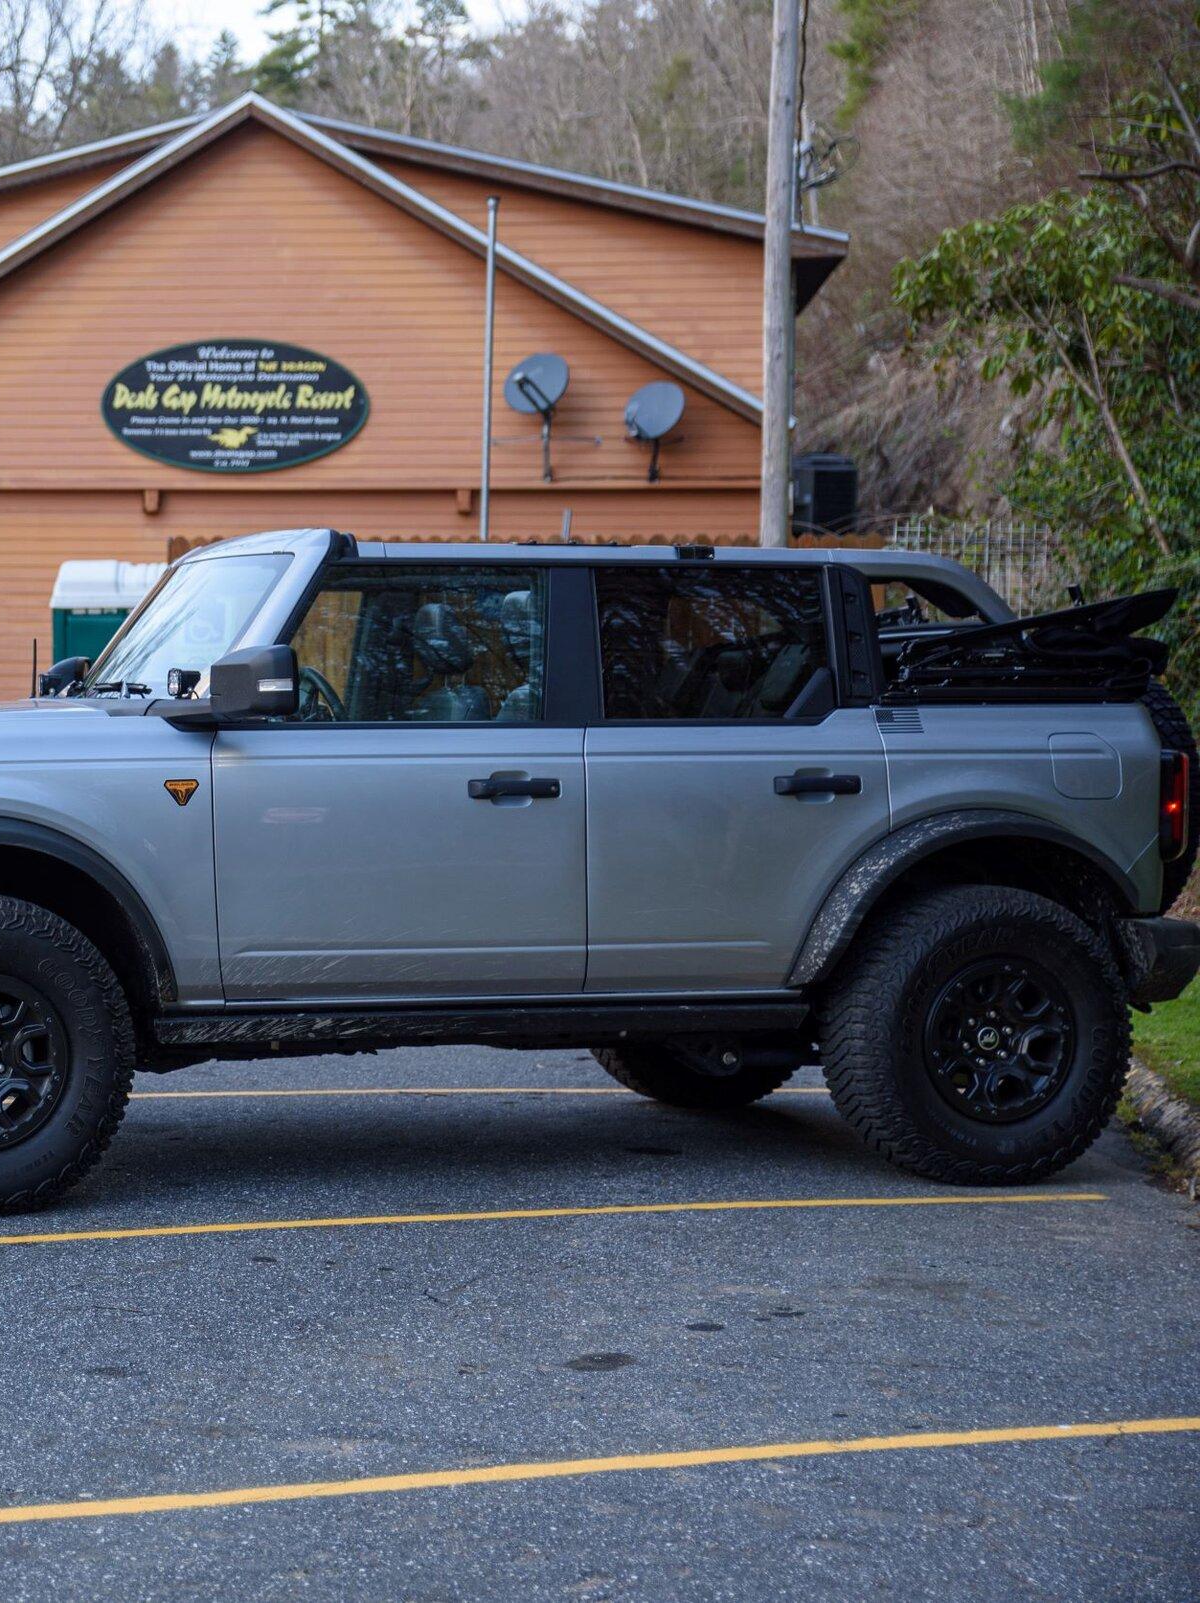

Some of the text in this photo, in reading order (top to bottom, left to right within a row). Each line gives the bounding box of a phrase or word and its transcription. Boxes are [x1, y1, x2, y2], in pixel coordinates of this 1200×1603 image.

[197, 346, 275, 359] Welcome to
[145, 361, 166, 372] The
[167, 360, 207, 372] Official
[209, 361, 247, 373] Home
[194, 373, 255, 383] Motorcycle
[256, 373, 320, 382] Destination
[161, 383, 198, 416] Gap
[199, 382, 293, 415] Motorcycle
[295, 384, 356, 410] Resort
